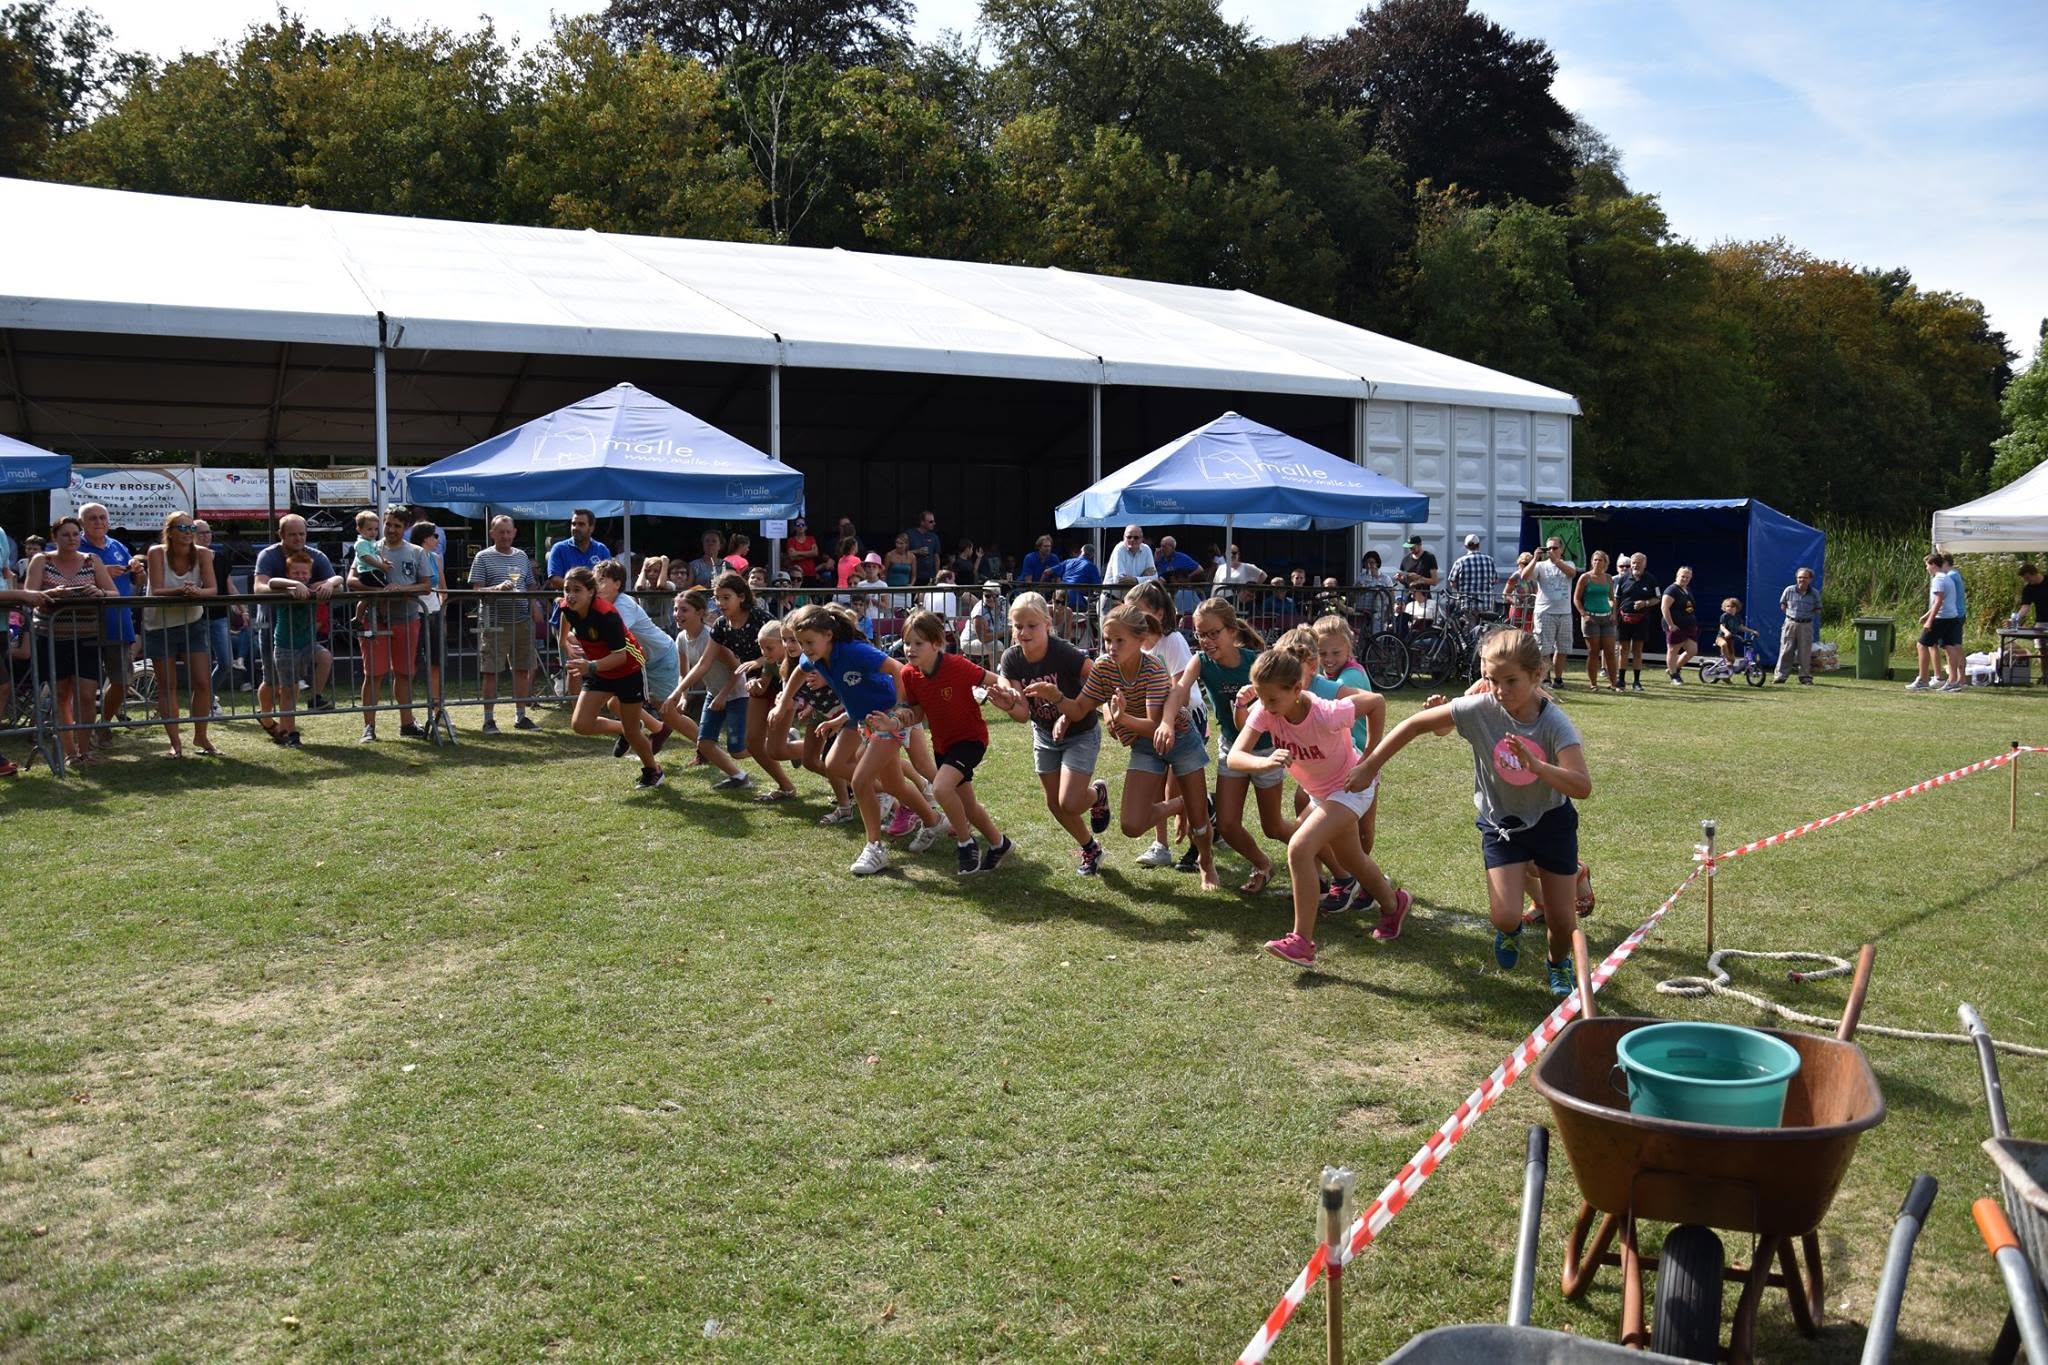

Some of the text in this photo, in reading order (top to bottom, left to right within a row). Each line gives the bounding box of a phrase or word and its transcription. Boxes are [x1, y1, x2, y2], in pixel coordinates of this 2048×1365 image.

[602, 439, 694, 457] malle
[624, 453, 731, 468] www.malle.be
[6, 466, 39, 479] malle
[1255, 462, 1328, 479] malle
[84, 482, 171, 491] GERY BROSENS
[1281, 475, 1363, 488] www.malle.be
[449, 482, 476, 494] malle
[744, 487, 770, 495] malle
[72, 493, 125, 502] Verwarming
[1383, 506, 1405, 515] malle
